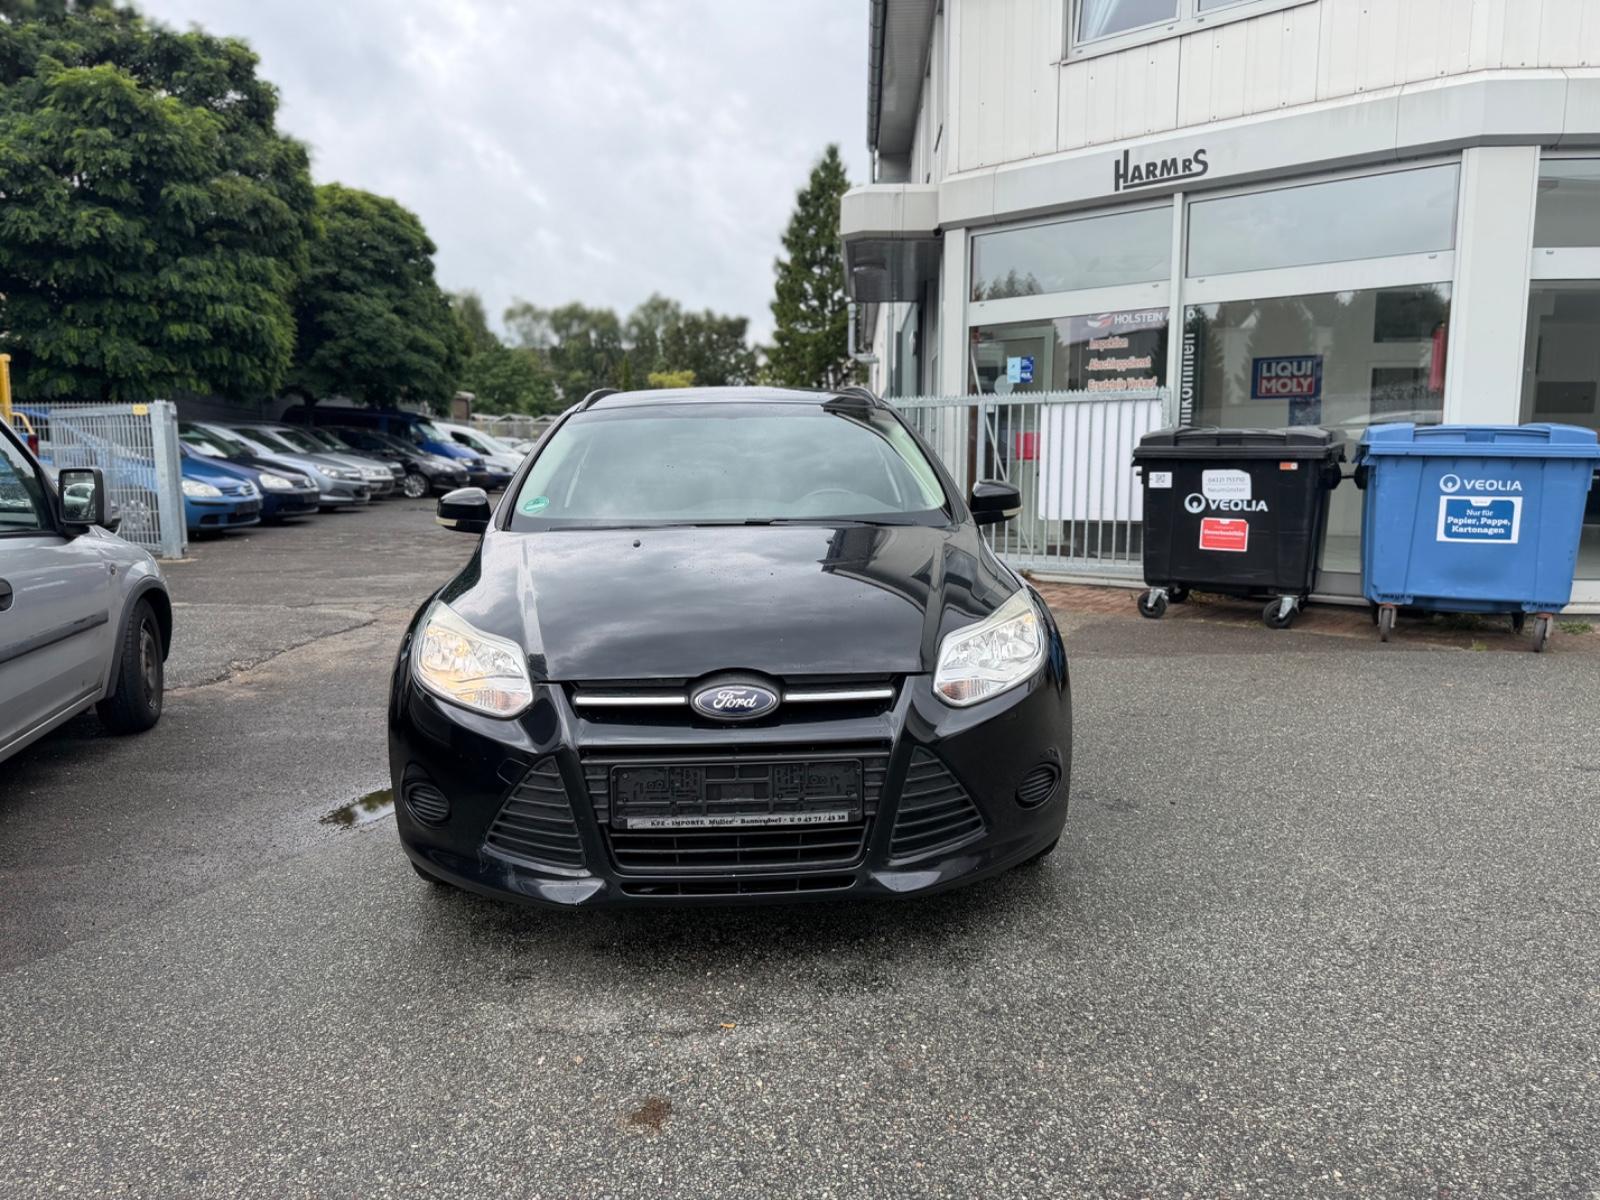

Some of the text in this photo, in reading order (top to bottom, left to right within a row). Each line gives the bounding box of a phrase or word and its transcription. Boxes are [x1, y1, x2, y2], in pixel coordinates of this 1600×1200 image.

[1114, 312, 1163, 324] HOLSTEIN
[1089, 336, 1129, 352] Inspektion
[1088, 355, 1152, 372] Abschleppdienst
[1262, 360, 1313, 377] LIQUI
[1181, 333, 1195, 428] illkommen
[1261, 377, 1313, 394] MOLY
[1463, 479, 1523, 492] VEOLIA
[1208, 499, 1269, 512] VEOLIA
[1466, 509, 1494, 517] Nur für
[1447, 516, 1512, 527] Papier, Pappe,
[1451, 525, 1505, 536] Kartonagen
[713, 690, 758, 709] Ford
